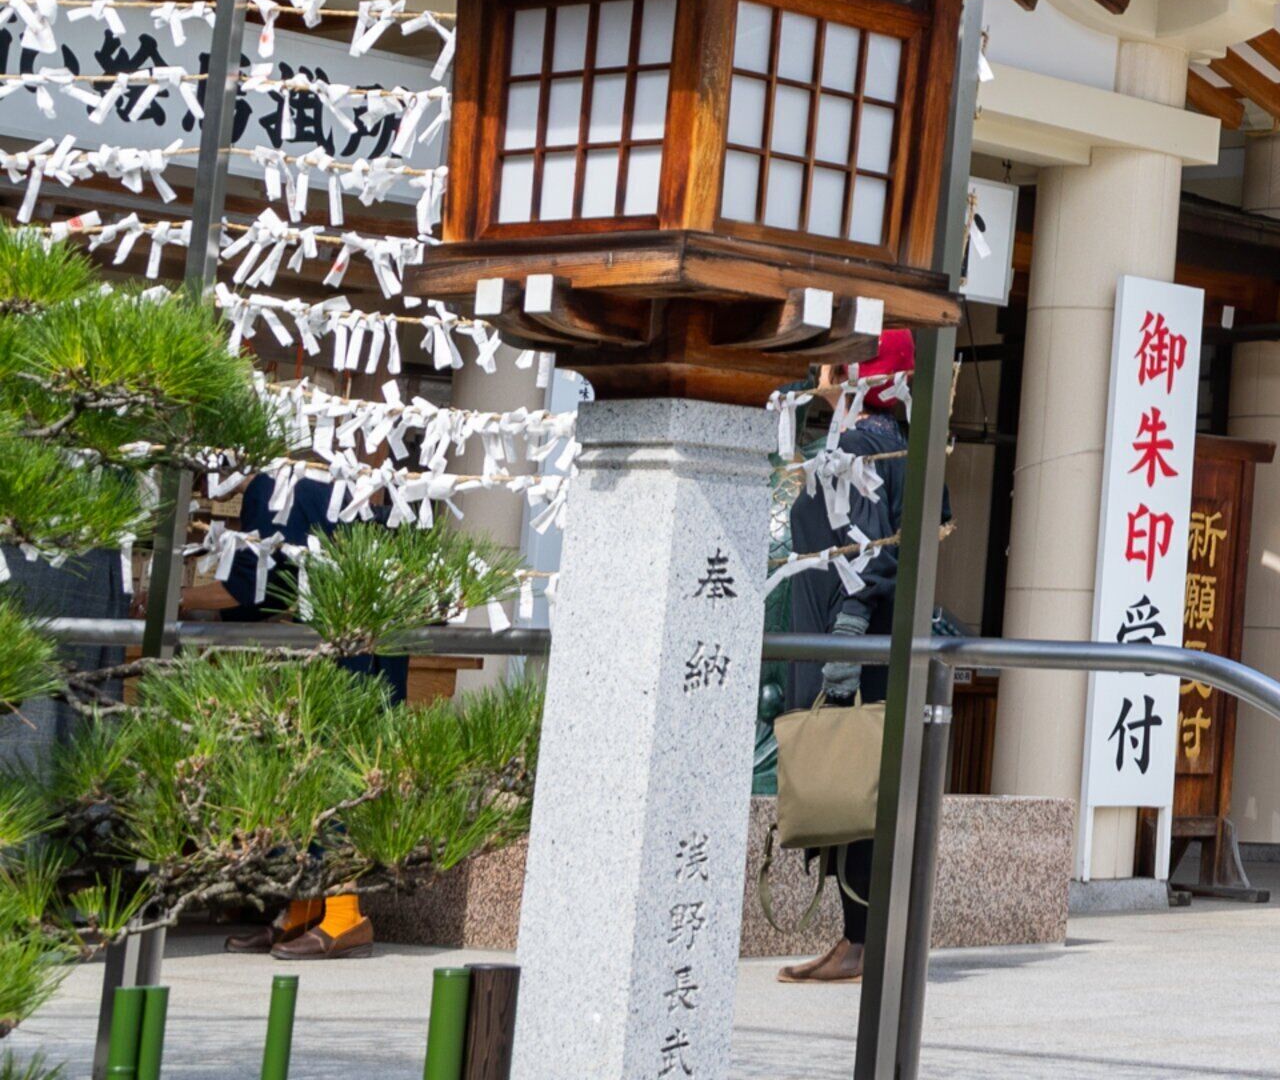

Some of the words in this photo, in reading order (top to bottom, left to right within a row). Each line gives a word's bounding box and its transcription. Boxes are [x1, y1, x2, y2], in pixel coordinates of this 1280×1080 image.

[683, 547, 738, 694] 奉納
[1106, 310, 1188, 776] 御朱印受付
